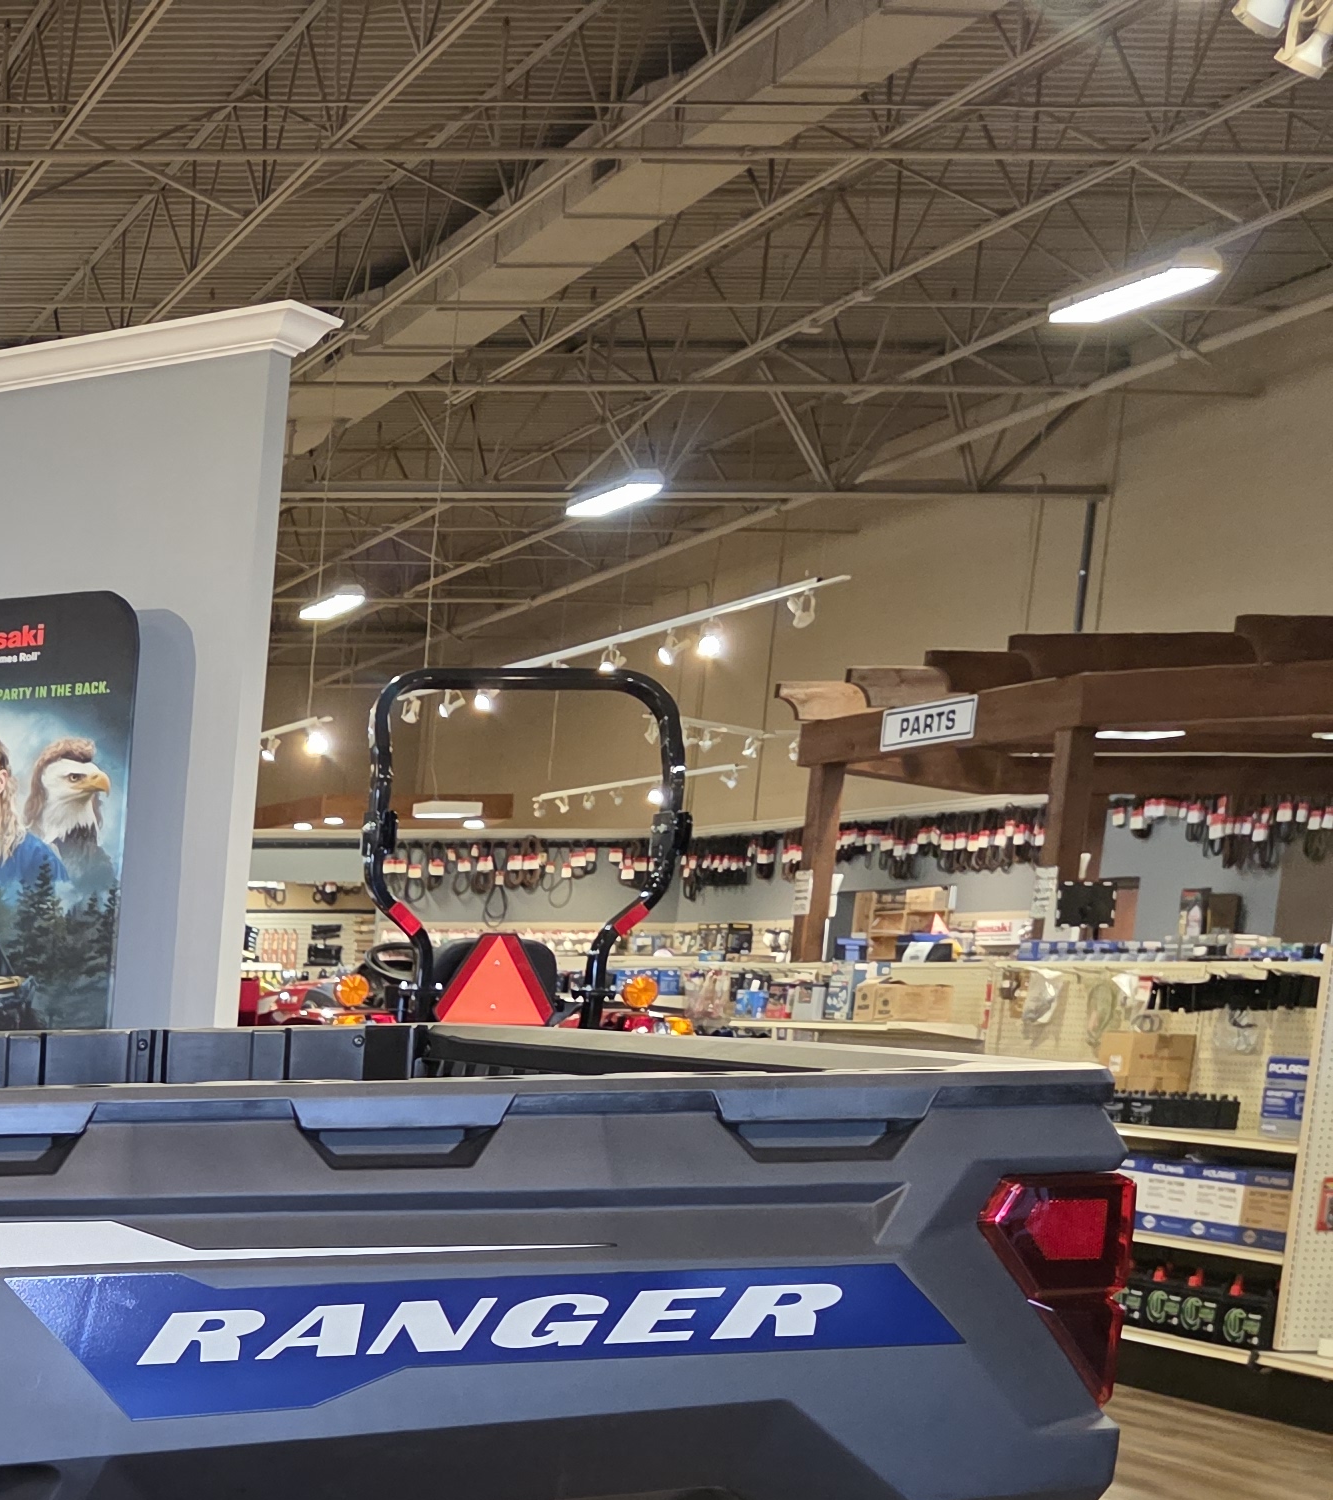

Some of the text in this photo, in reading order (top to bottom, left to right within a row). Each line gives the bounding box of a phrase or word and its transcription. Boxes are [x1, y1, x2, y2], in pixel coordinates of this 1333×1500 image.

[19, 652, 38, 662] Roll
[35, 686, 47, 698] IN
[50, 684, 72, 697] THE
[75, 681, 110, 695] BACK.
[899, 709, 956, 738] PARTS
[136, 1283, 842, 1366] RANGER
